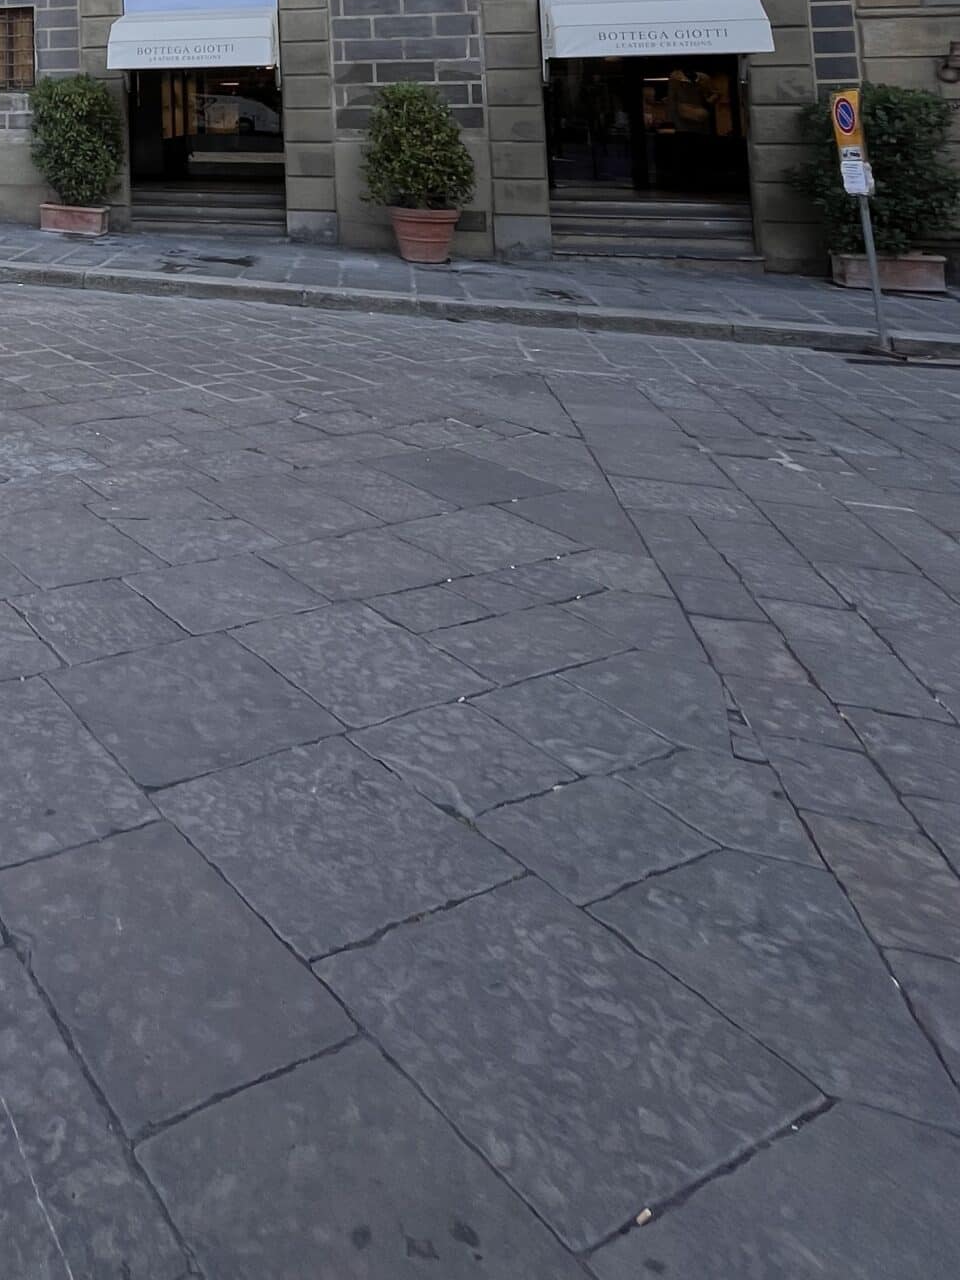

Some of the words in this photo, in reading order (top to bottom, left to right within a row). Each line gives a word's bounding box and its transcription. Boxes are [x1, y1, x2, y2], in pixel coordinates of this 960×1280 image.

[597, 30, 670, 42] BOTTEGA
[674, 27, 729, 40] GIOTTI
[136, 45, 191, 56] BOTTEGA
[193, 43, 235, 54] GIOTTI
